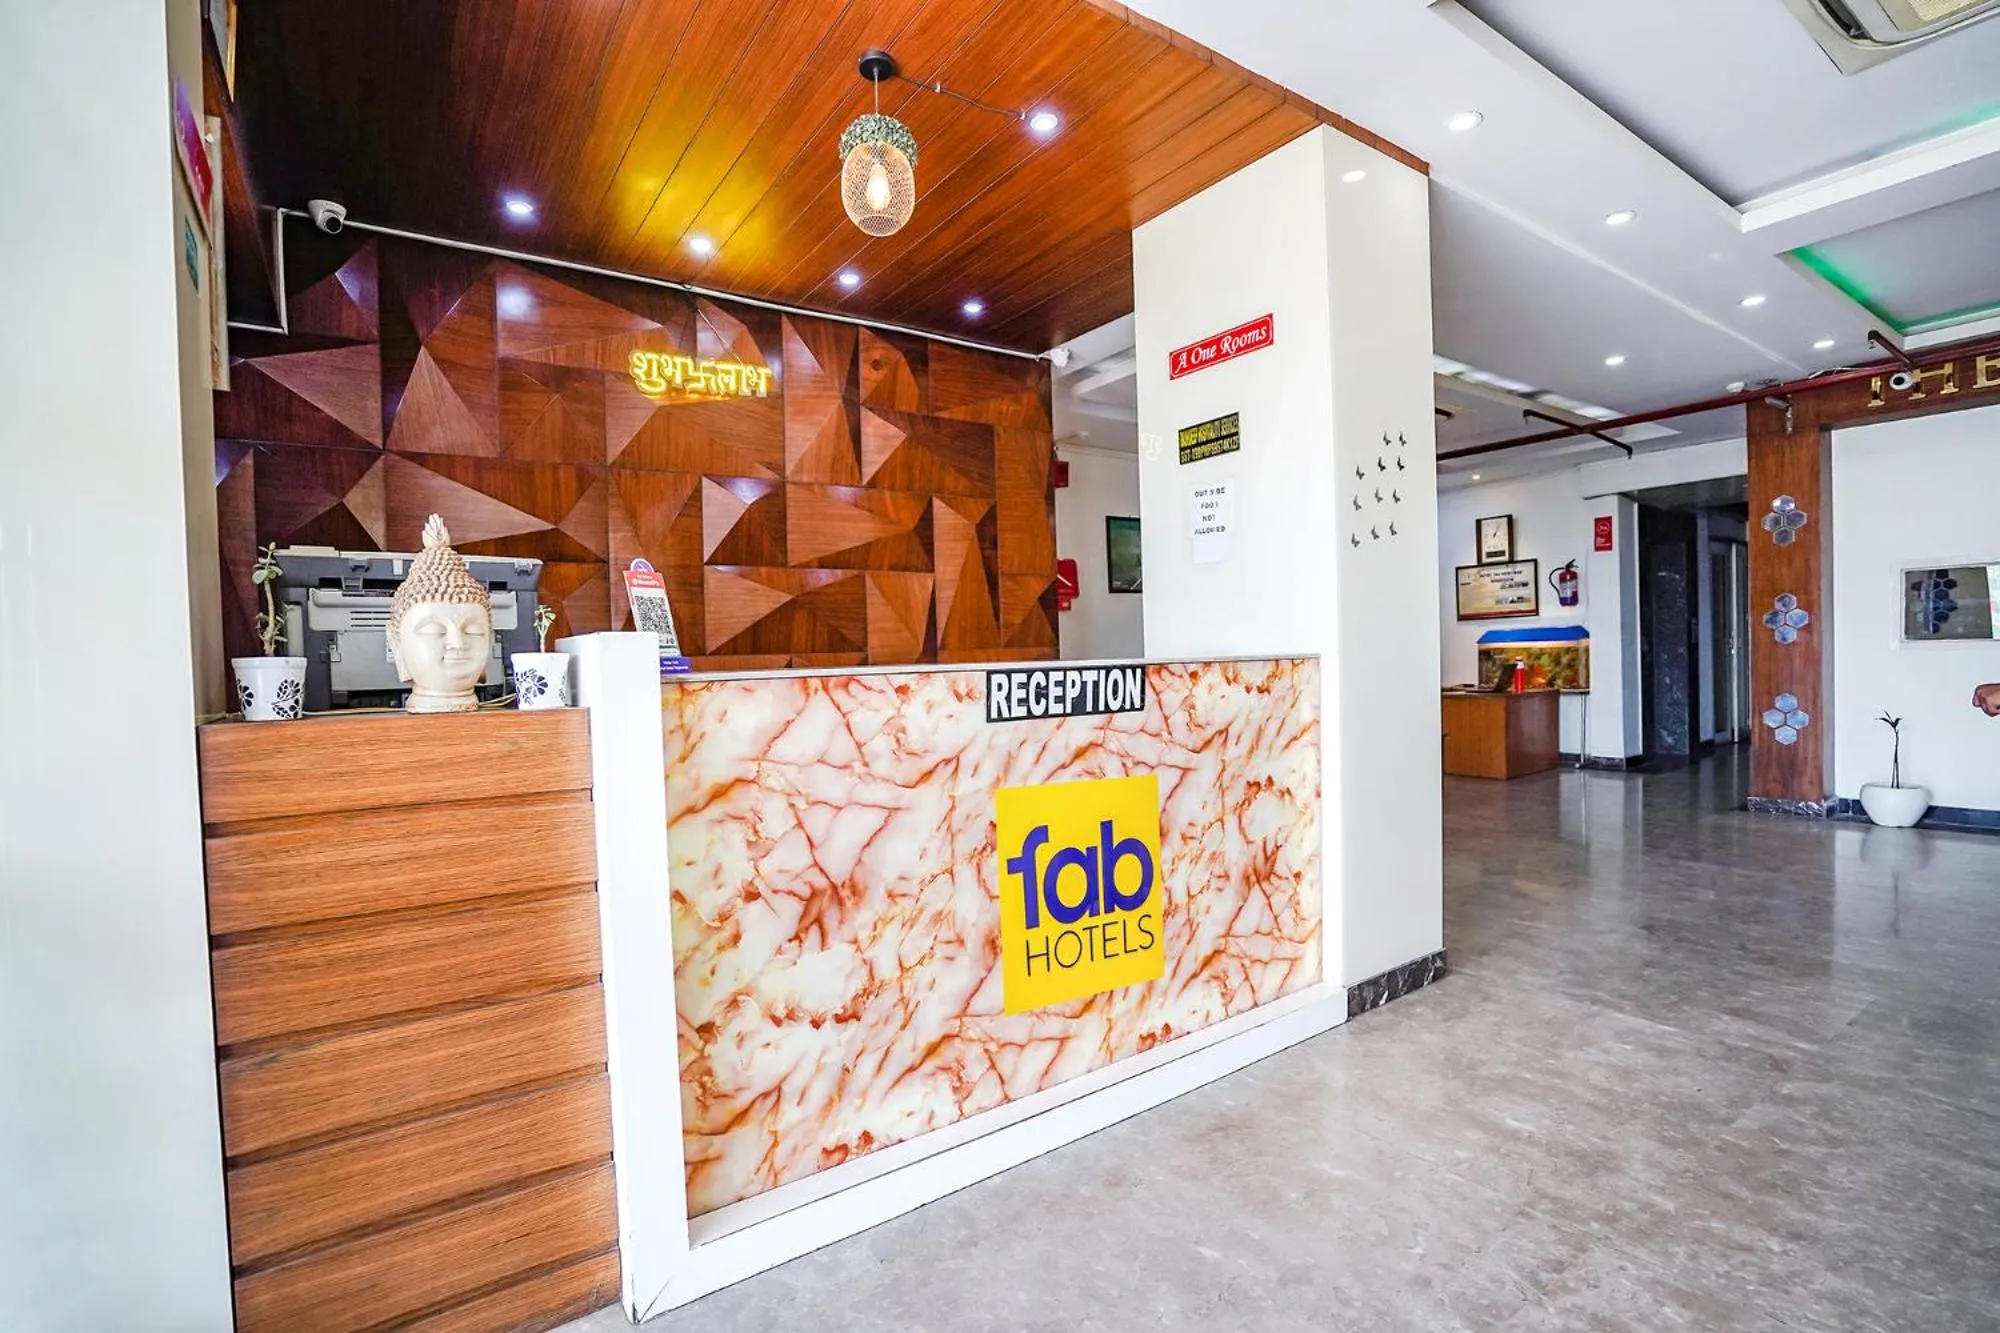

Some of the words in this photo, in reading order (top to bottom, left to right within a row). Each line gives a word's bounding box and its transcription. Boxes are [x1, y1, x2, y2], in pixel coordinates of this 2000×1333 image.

[1174, 351, 1188, 374] A
[1191, 345, 1217, 364] One
[1220, 325, 1268, 354] Rooms
[1194, 486, 1226, 498] OUTSDE
[989, 668, 1142, 720] RECEPTION
[1006, 819, 1155, 930] fab
[1025, 913, 1155, 978] HOTELS
